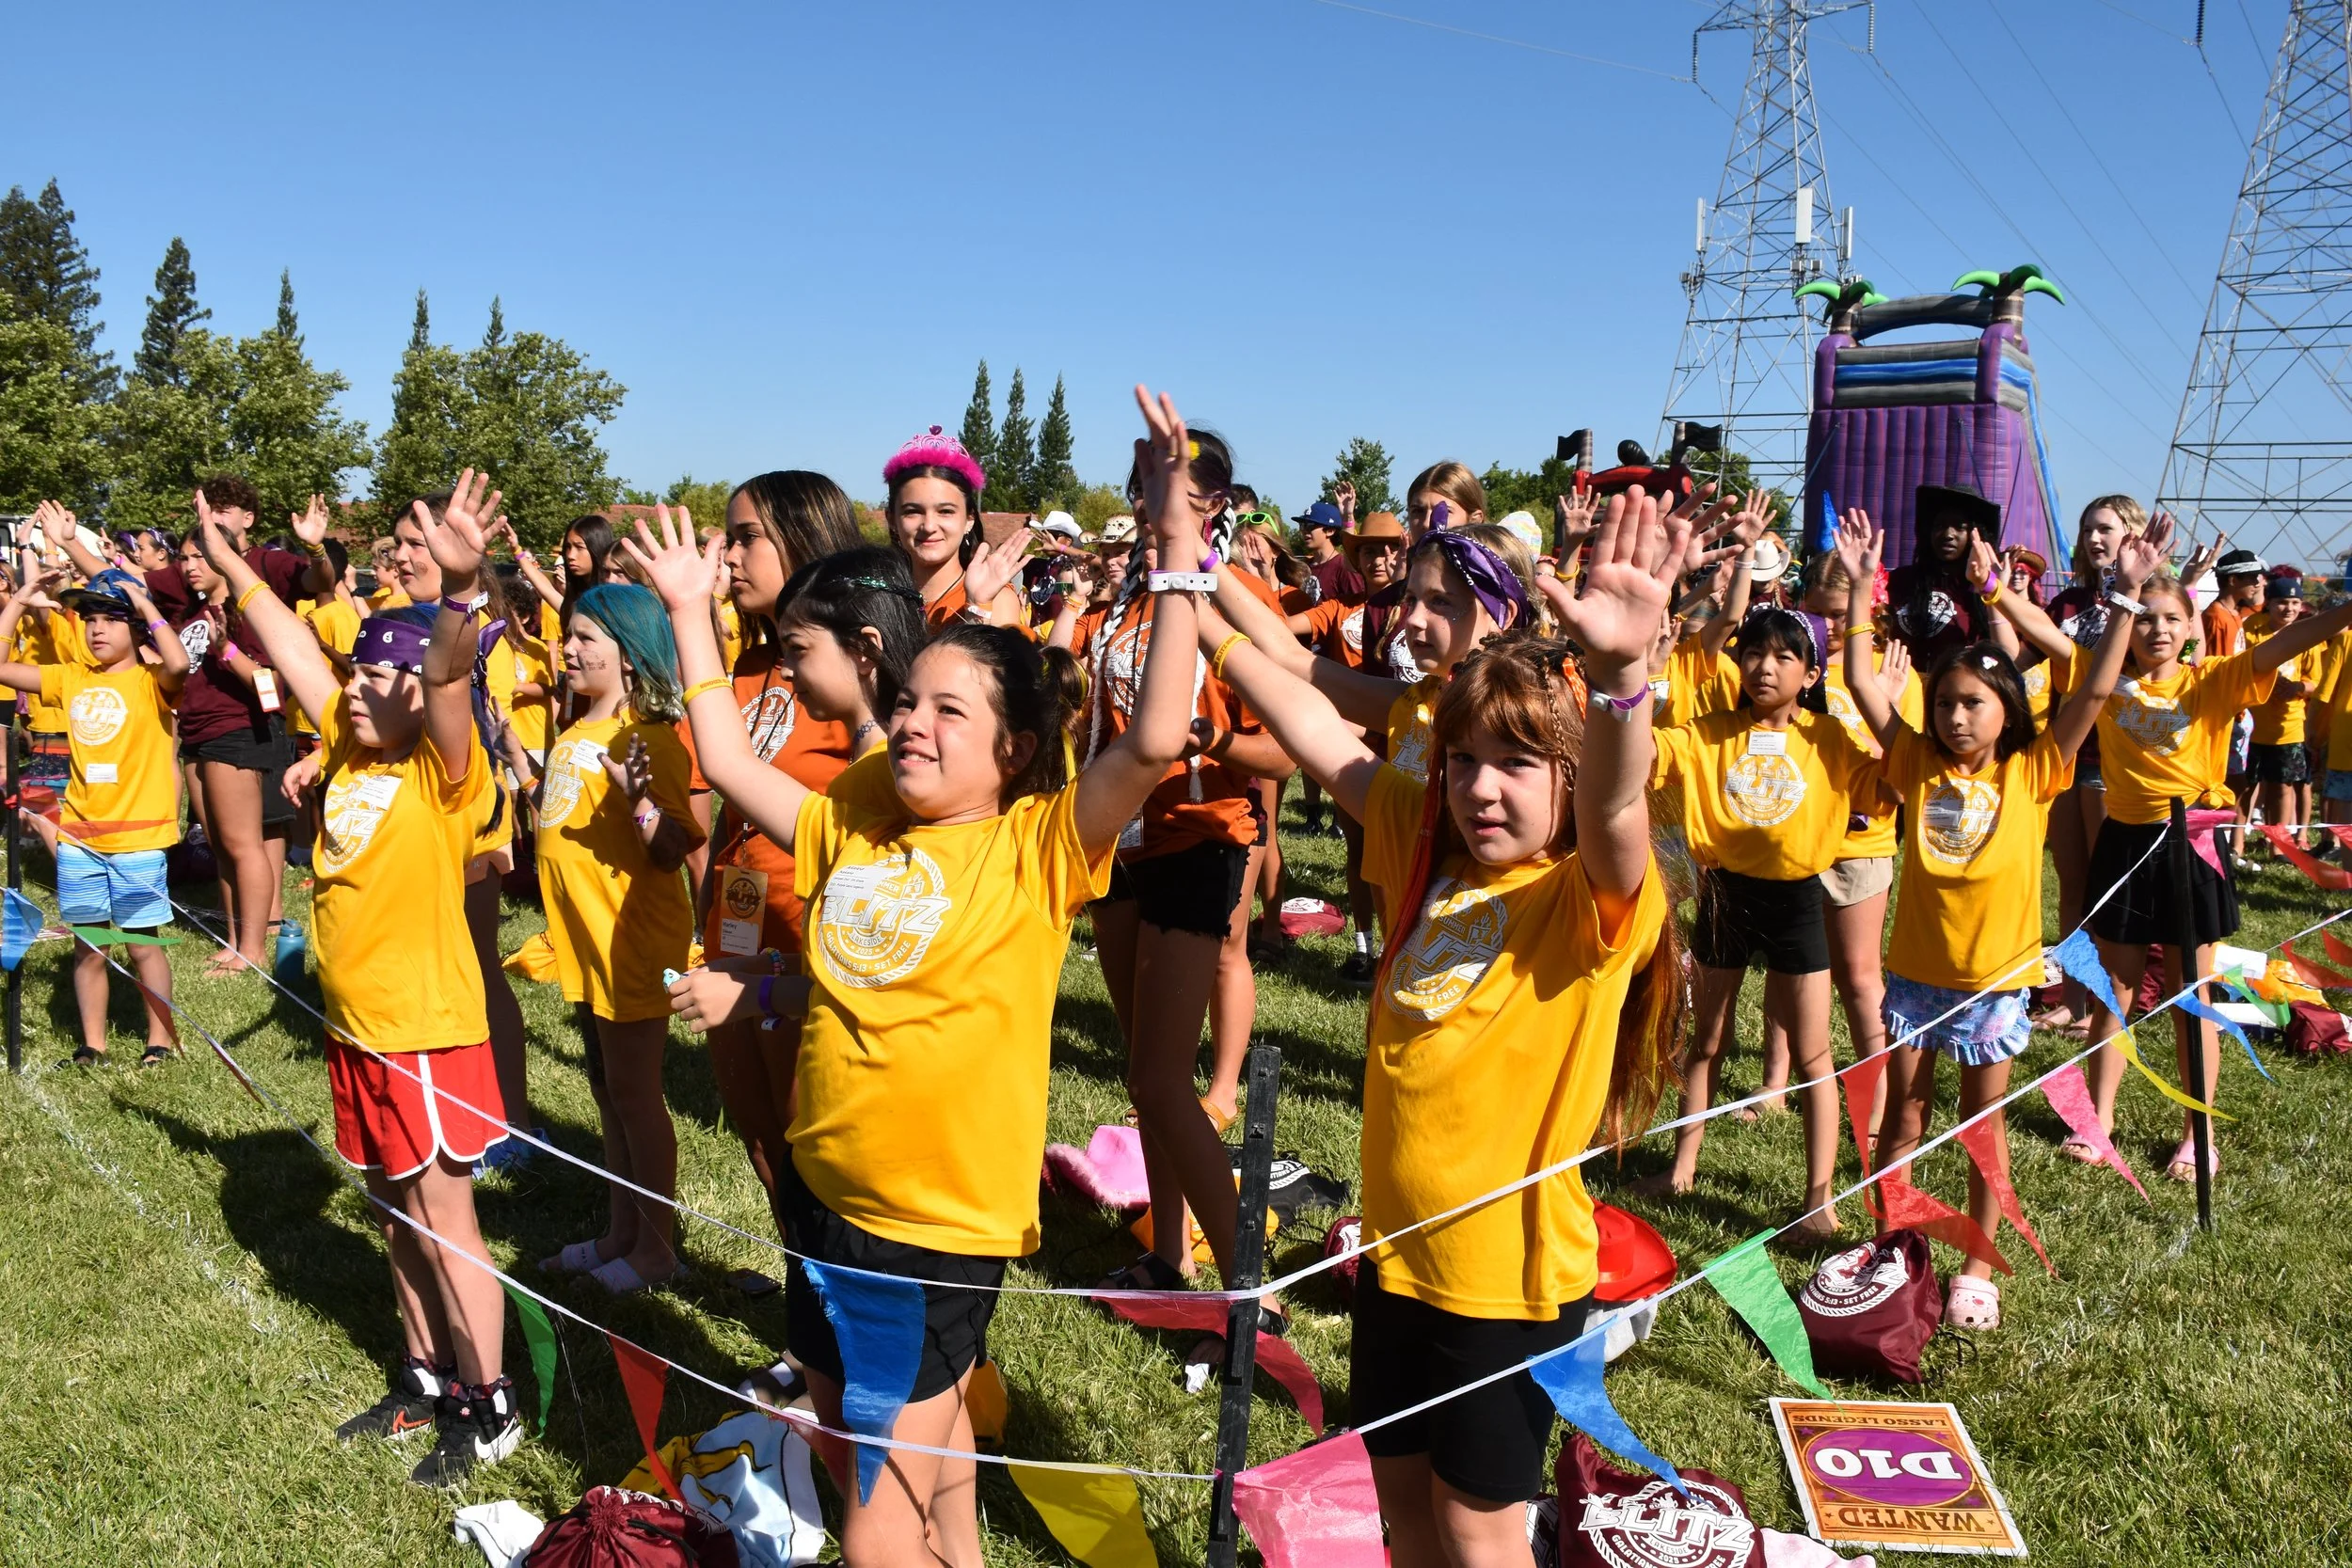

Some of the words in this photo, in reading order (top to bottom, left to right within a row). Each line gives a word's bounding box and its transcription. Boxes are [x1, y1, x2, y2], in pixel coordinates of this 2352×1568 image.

[1724, 775, 1807, 800] BLITZ
[820, 895, 951, 934] BLITZ
[1438, 915, 1466, 934] SUMMER
[850, 932, 882, 946] LAKESIDE
[826, 931, 851, 968] GALATIANS
[851, 962, 866, 973] 5:13
[874, 959, 892, 971] SET
[892, 940, 912, 962] FREE
[1417, 996, 1435, 1006] SET
[1437, 984, 1461, 1003] FREE
[1824, 1297, 1838, 1306] 5:13
[1843, 1295, 1858, 1305] SET
[1859, 1285, 1879, 1300] FREE
[1793, 1414, 1881, 1426] LEGENDS
[1883, 1416, 1947, 1428] LASSO
[1814, 1448, 1963, 1481] D10
[1578, 1503, 1755, 1551] BLITZ
[1838, 1507, 1986, 1533] WANTED
[1649, 1538, 1689, 1555] LAKESIDE
